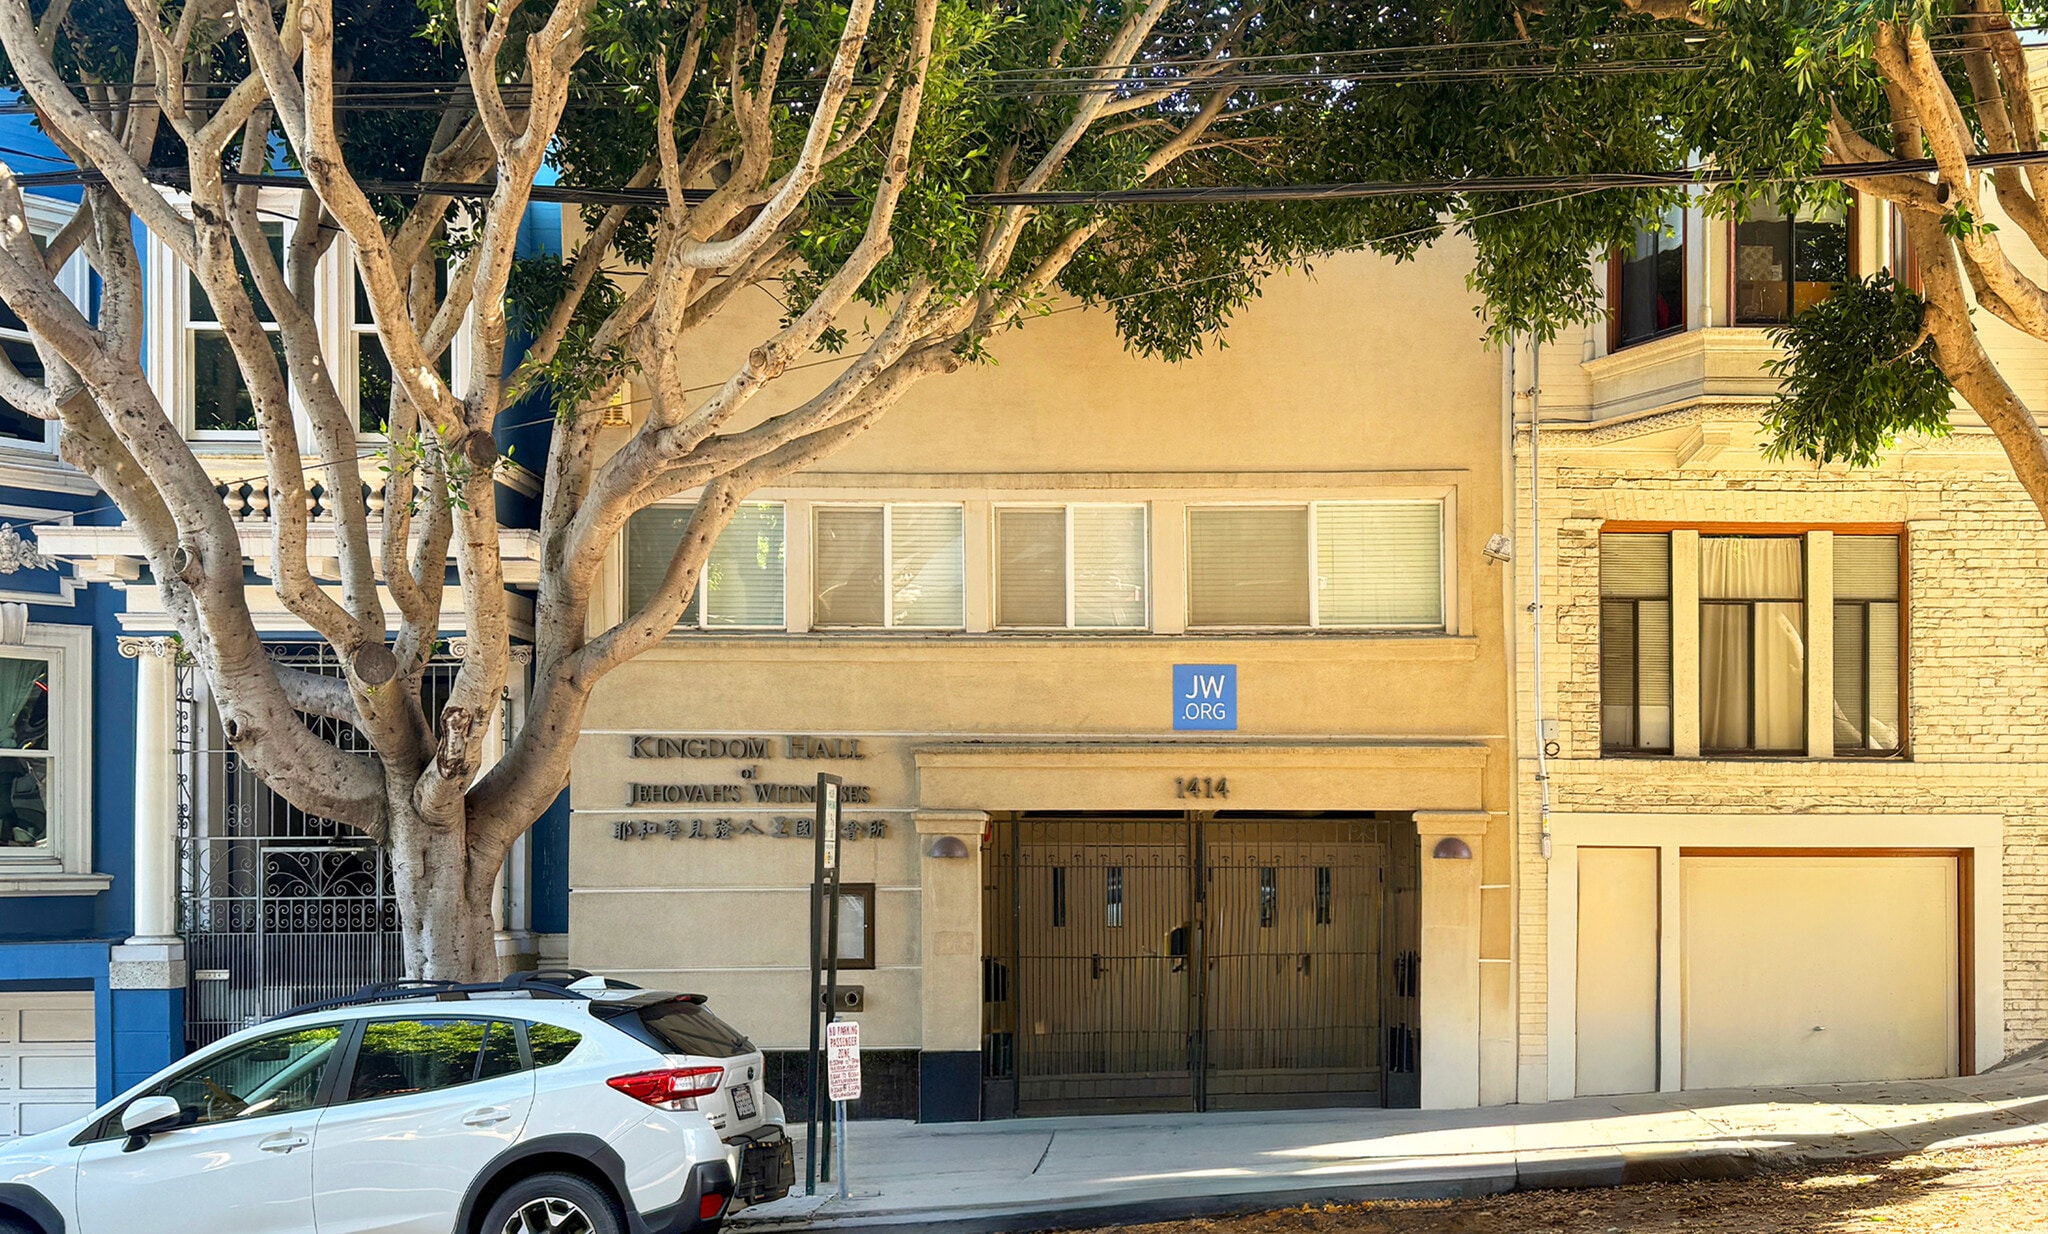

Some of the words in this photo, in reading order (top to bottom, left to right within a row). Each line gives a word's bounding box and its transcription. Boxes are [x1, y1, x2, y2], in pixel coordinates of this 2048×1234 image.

[1185, 675, 1226, 699] JW
[1182, 702, 1226, 720] .ORG
[628, 735, 771, 759] KINGDOM
[785, 735, 865, 760] HALL
[738, 765, 758, 780] of
[625, 782, 742, 807] JEHOVAH'S
[752, 783, 871, 804] WITNSES
[1175, 776, 1230, 800] 1414
[612, 816, 888, 841] 耶和華見證人王國會所
